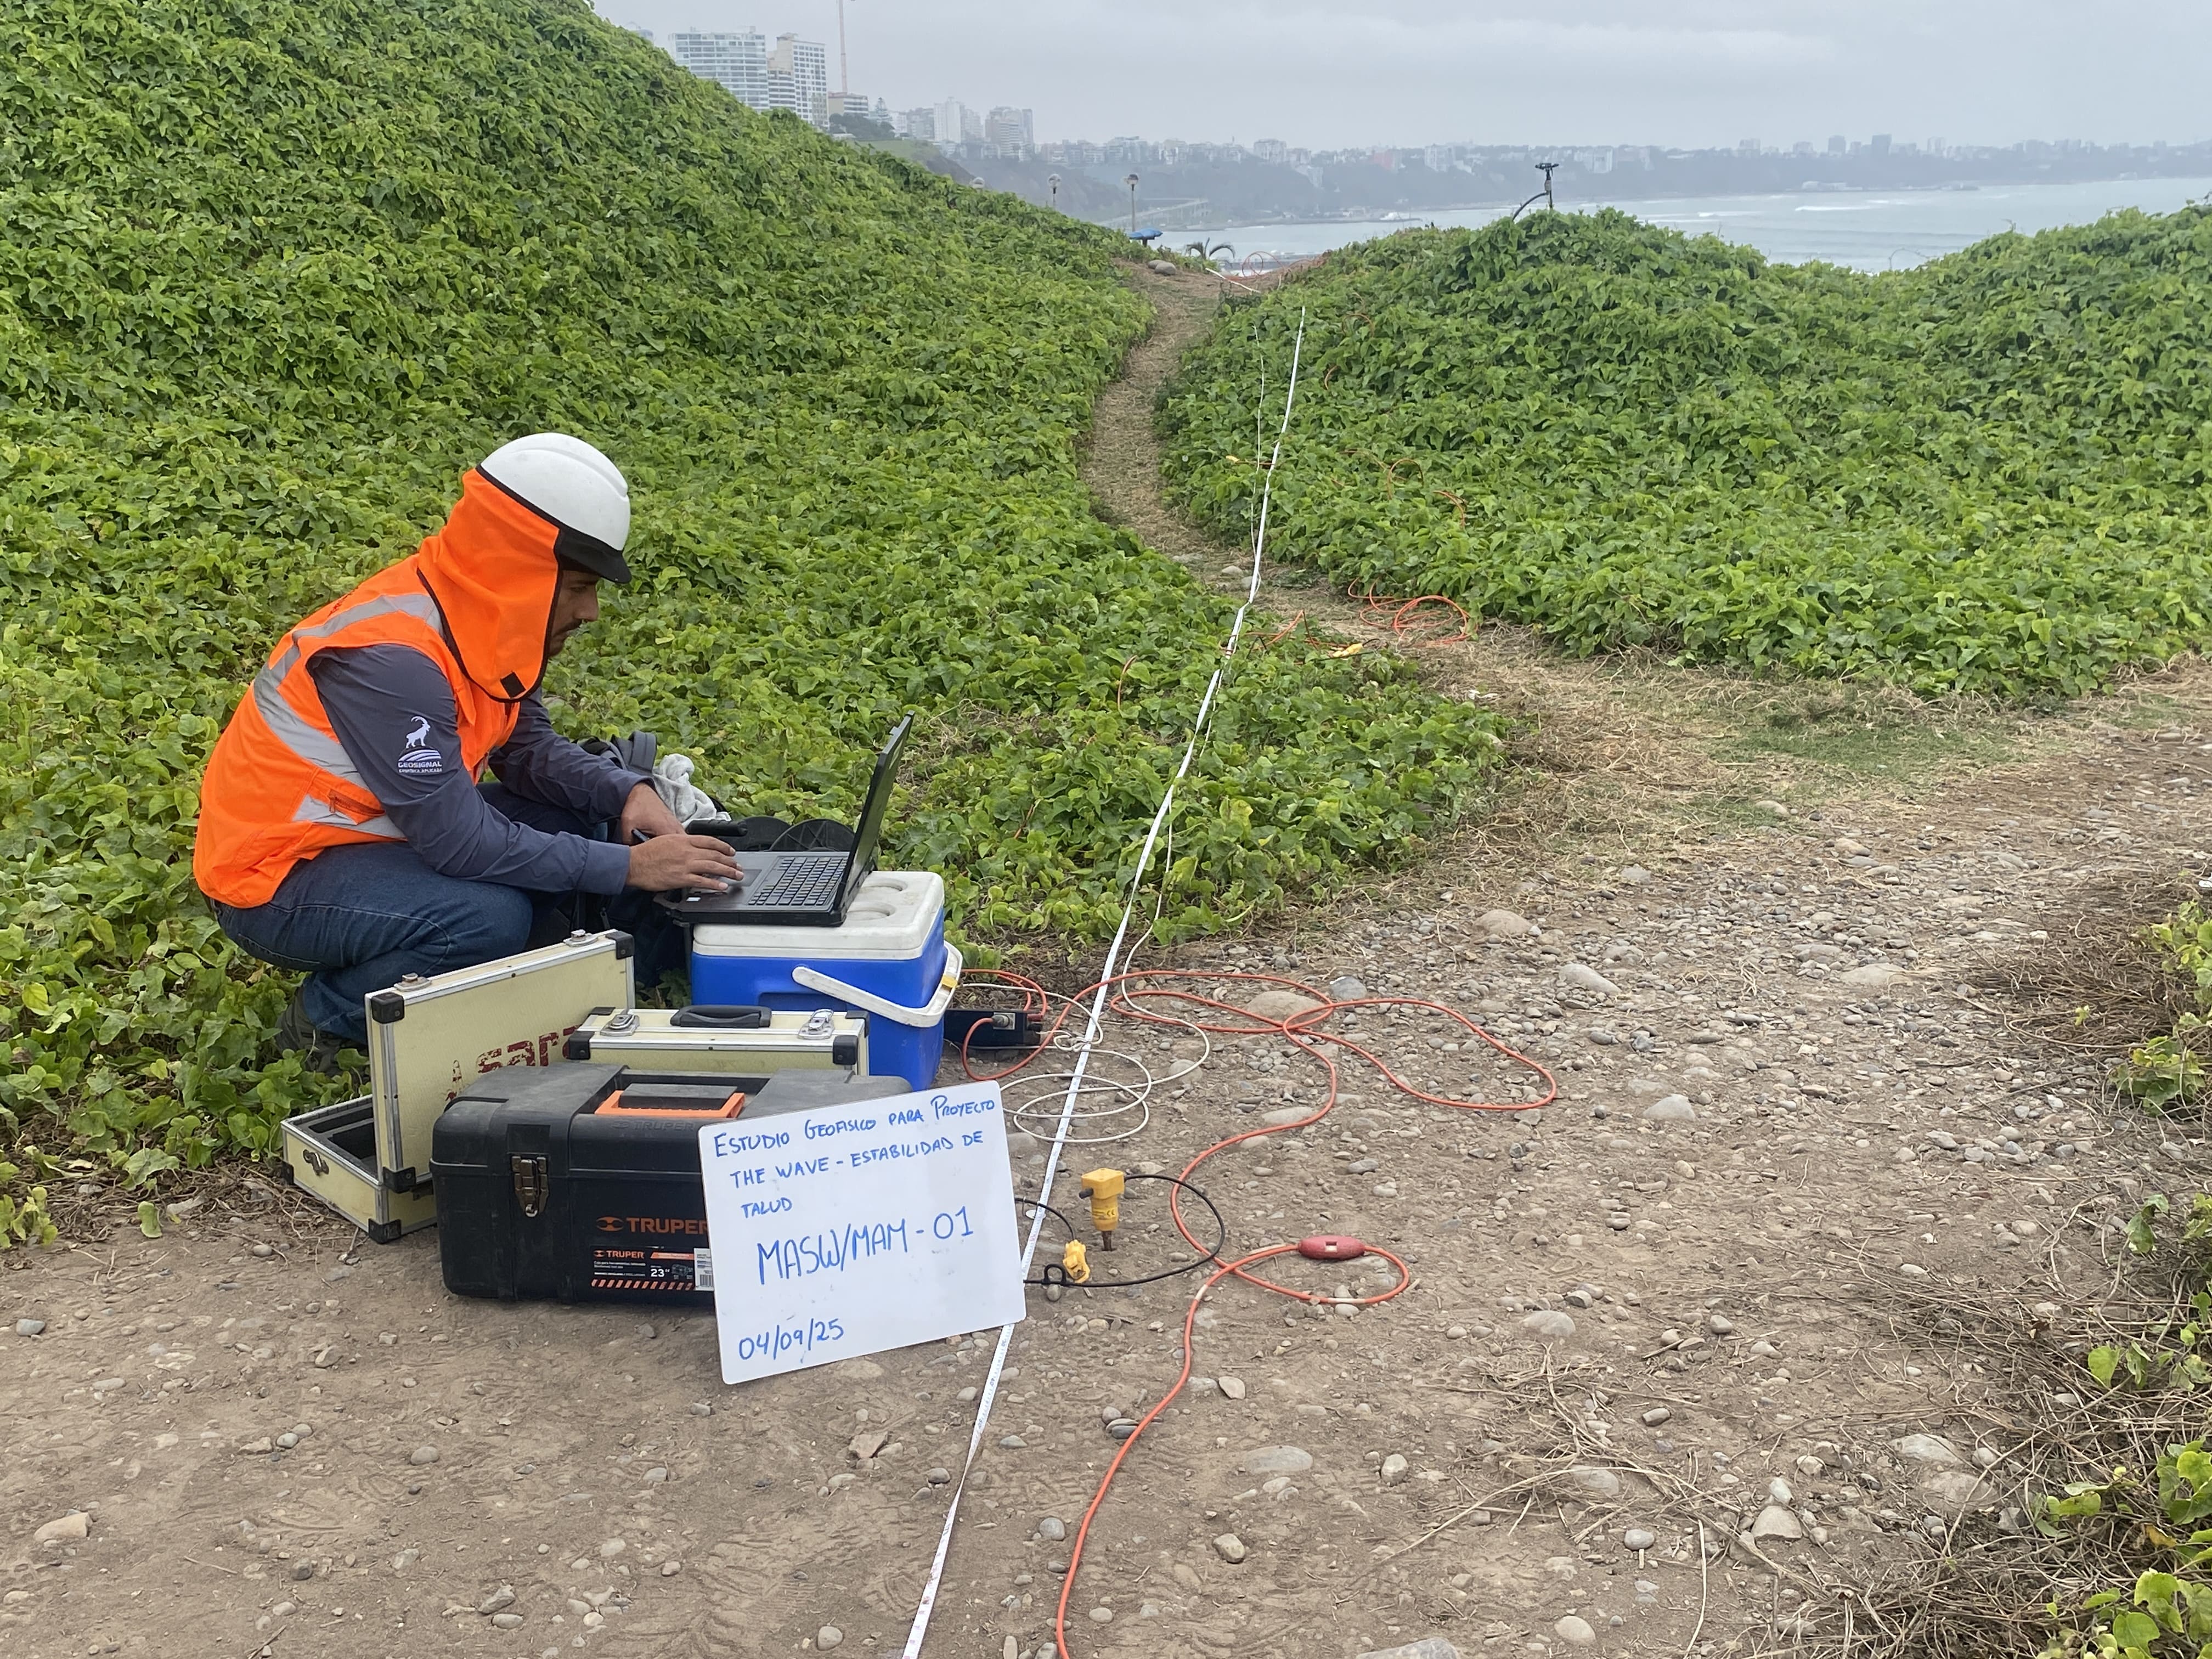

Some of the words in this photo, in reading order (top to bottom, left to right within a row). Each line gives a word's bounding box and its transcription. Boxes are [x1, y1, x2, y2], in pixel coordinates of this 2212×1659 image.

[714, 1132, 790, 1158] ESTUDIO
[804, 1119, 877, 1140] GEOFISICO
[888, 1109, 925, 1125] PARA
[930, 1095, 995, 1120] PROYECTO
[730, 1169, 765, 1188] THE
[775, 1156, 830, 1178] WAVE
[850, 1137, 953, 1167] ESTABILIDAD
[962, 1130, 983, 1147] DE
[741, 1197, 793, 1218] TALUD
[933, 1206, 974, 1240] 01
[606, 1250, 645, 1259] TRUPER
[738, 1318, 844, 1361] 04/09/25
